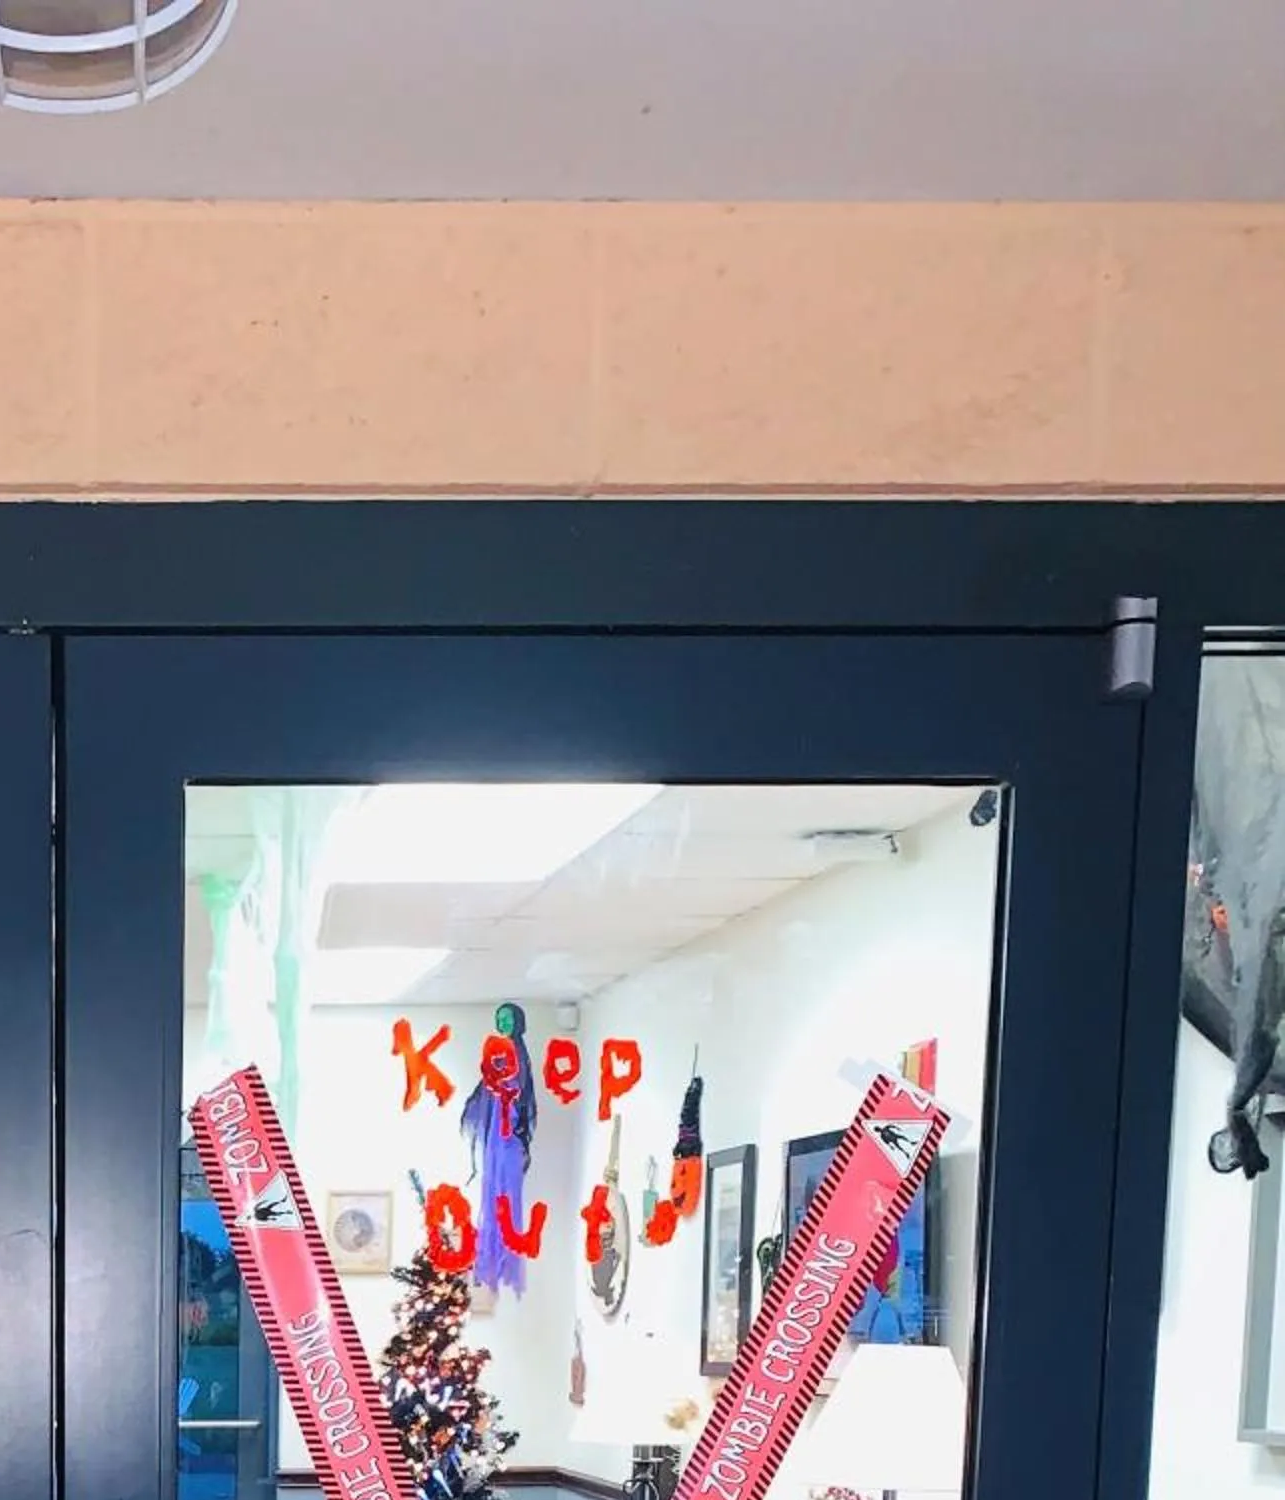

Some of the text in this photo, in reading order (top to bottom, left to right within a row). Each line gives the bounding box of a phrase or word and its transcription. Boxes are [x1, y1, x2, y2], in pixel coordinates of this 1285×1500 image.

[391, 1017, 642, 1138] Keep
[760, 1232, 858, 1384] CROSSING
[287, 1309, 372, 1459] CROSSING
